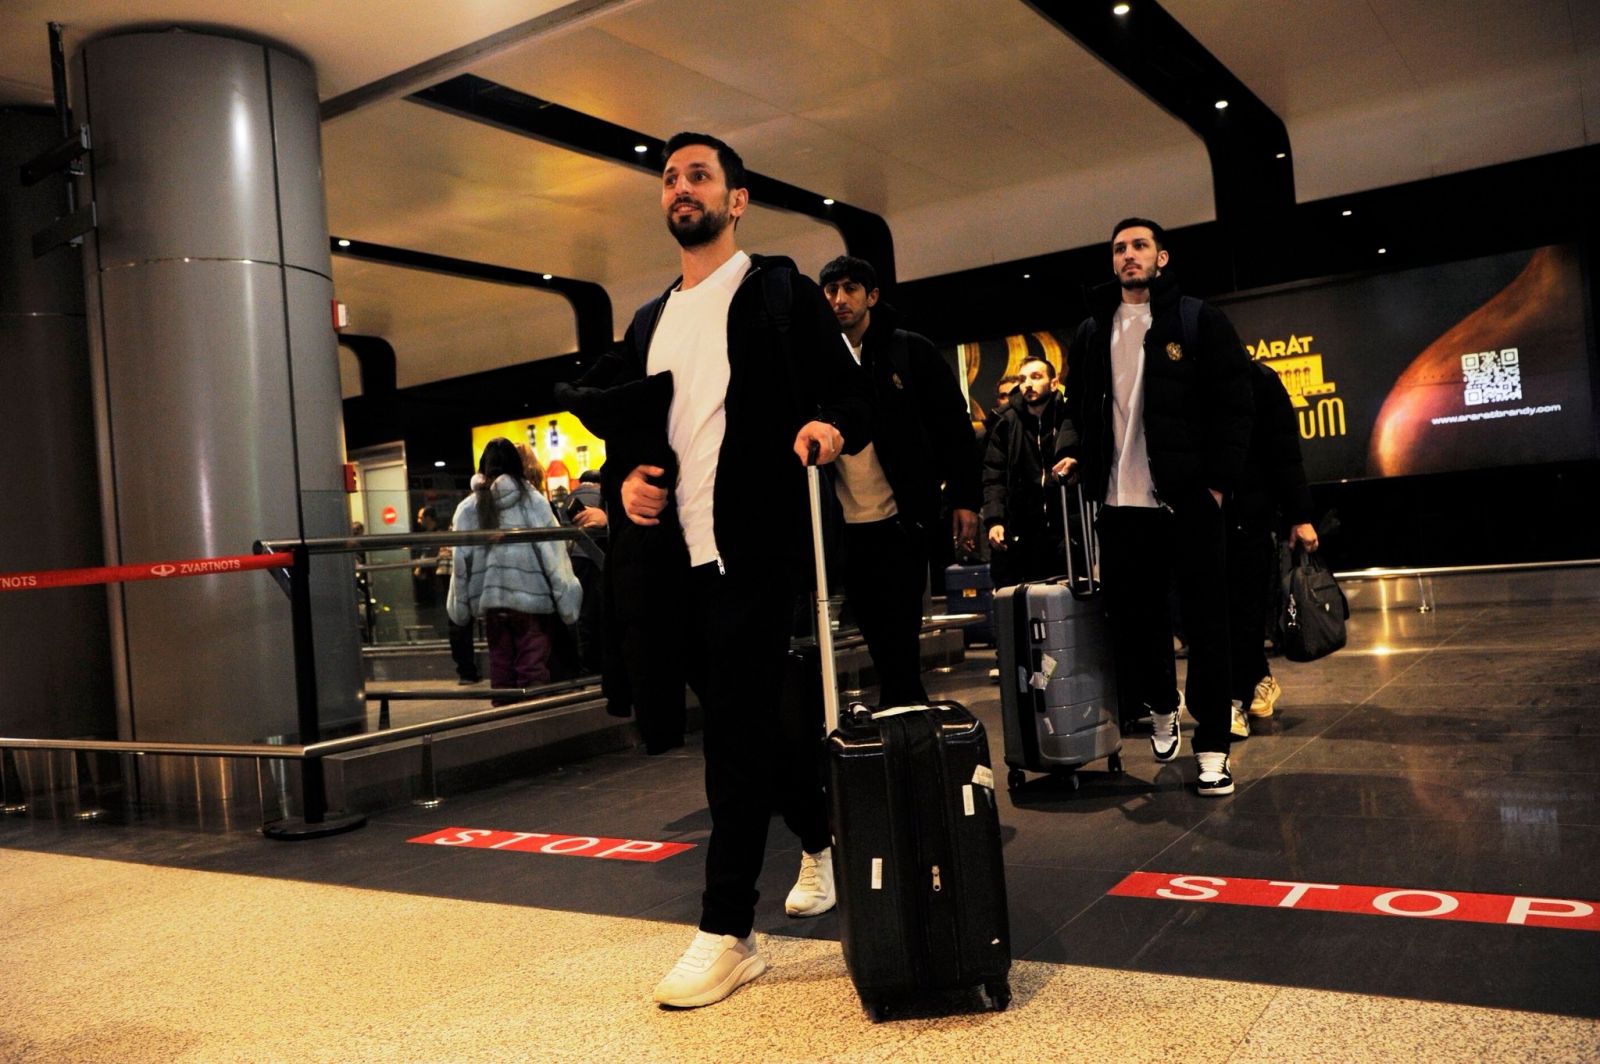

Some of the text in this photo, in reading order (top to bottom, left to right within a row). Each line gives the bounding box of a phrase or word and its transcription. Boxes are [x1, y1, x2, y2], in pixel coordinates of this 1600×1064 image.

[1431, 404, 1562, 425] www.araratbrandy.com
[180, 559, 241, 574] ZVARTNOTS
[434, 829, 663, 858] STOP
[1156, 876, 1595, 925] STOP
